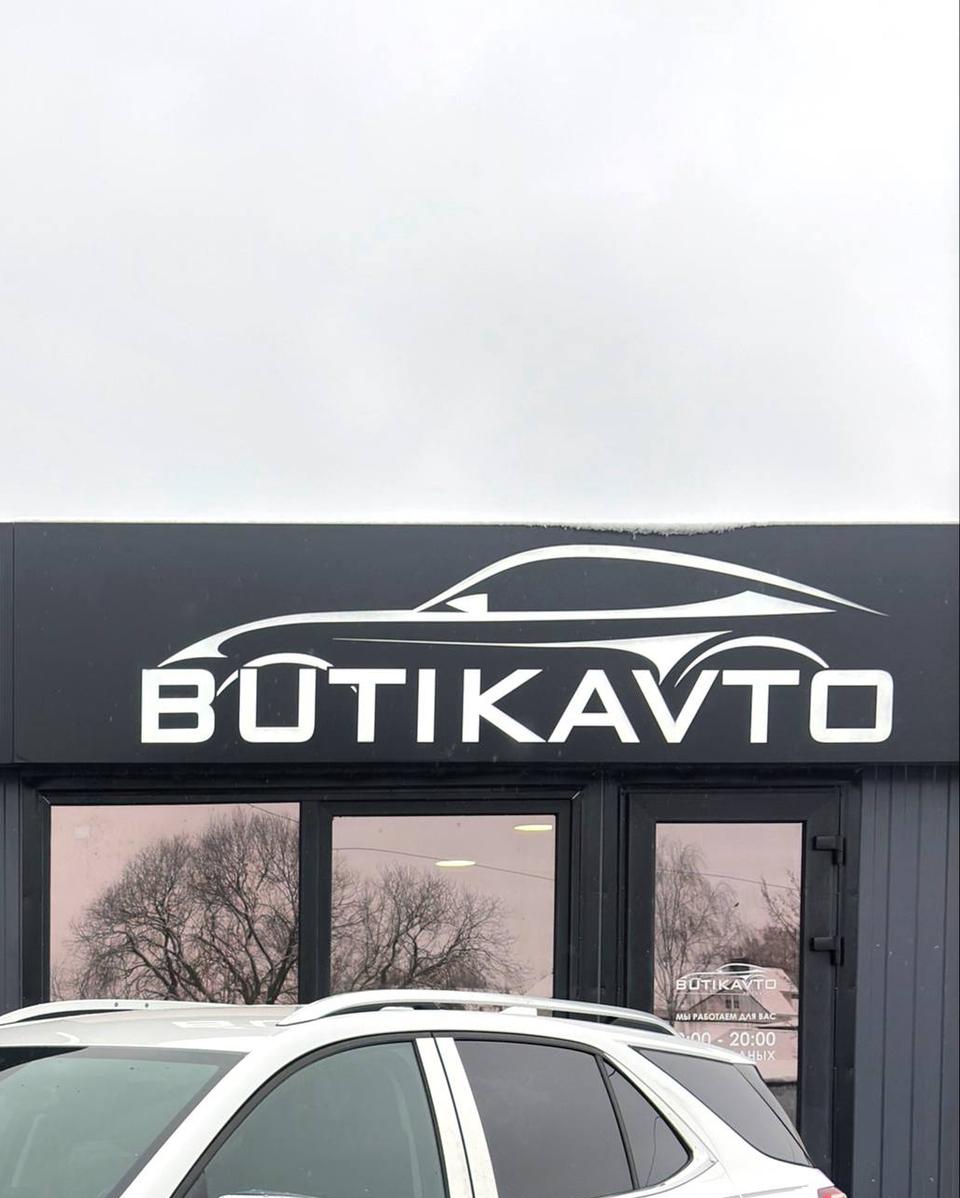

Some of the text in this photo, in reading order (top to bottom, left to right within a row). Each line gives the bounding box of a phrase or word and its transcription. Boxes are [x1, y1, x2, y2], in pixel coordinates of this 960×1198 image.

[140, 667, 895, 746] BUTIKAVTO
[675, 978, 777, 991] BUTIKAVTO
[675, 1012, 777, 1022] МЫ РАБОТАЕМ ДЛЯ ВАС
[729, 1031, 777, 1047] 20:00
